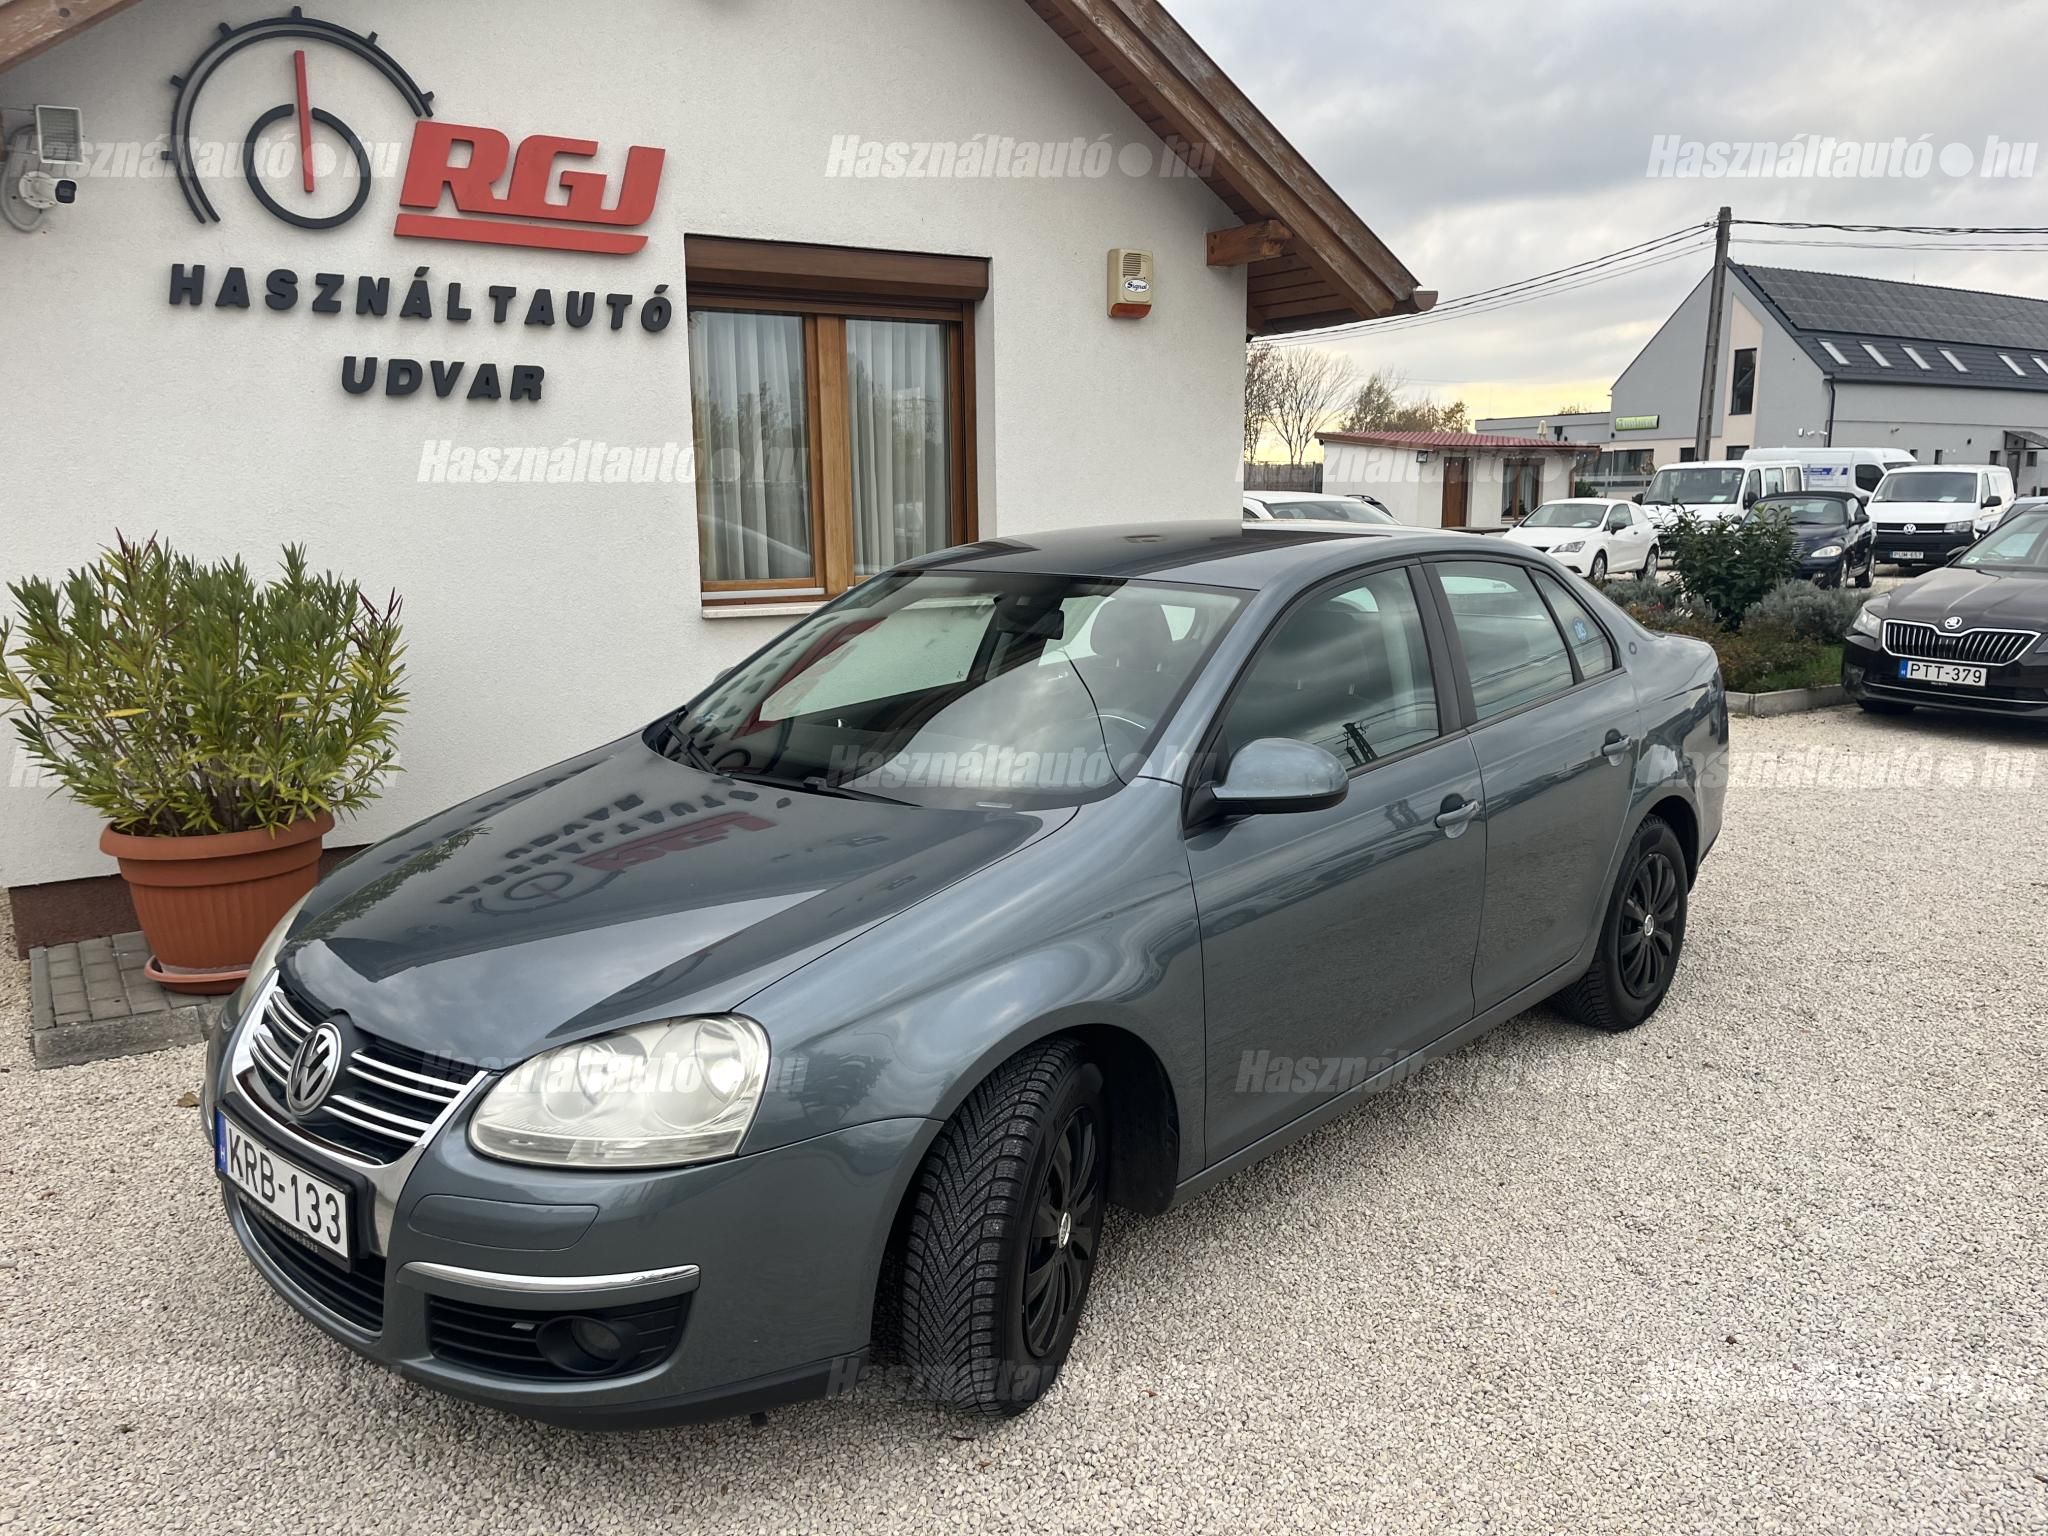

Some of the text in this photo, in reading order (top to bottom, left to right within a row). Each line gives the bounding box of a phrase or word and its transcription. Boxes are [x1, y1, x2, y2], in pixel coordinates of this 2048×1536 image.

[168, 264, 672, 332] HASZNÁLTAUTÓ
[341, 356, 545, 401] UDVAR
[1910, 663, 1983, 684] PTT-379
[228, 1127, 341, 1245] KRB-133
